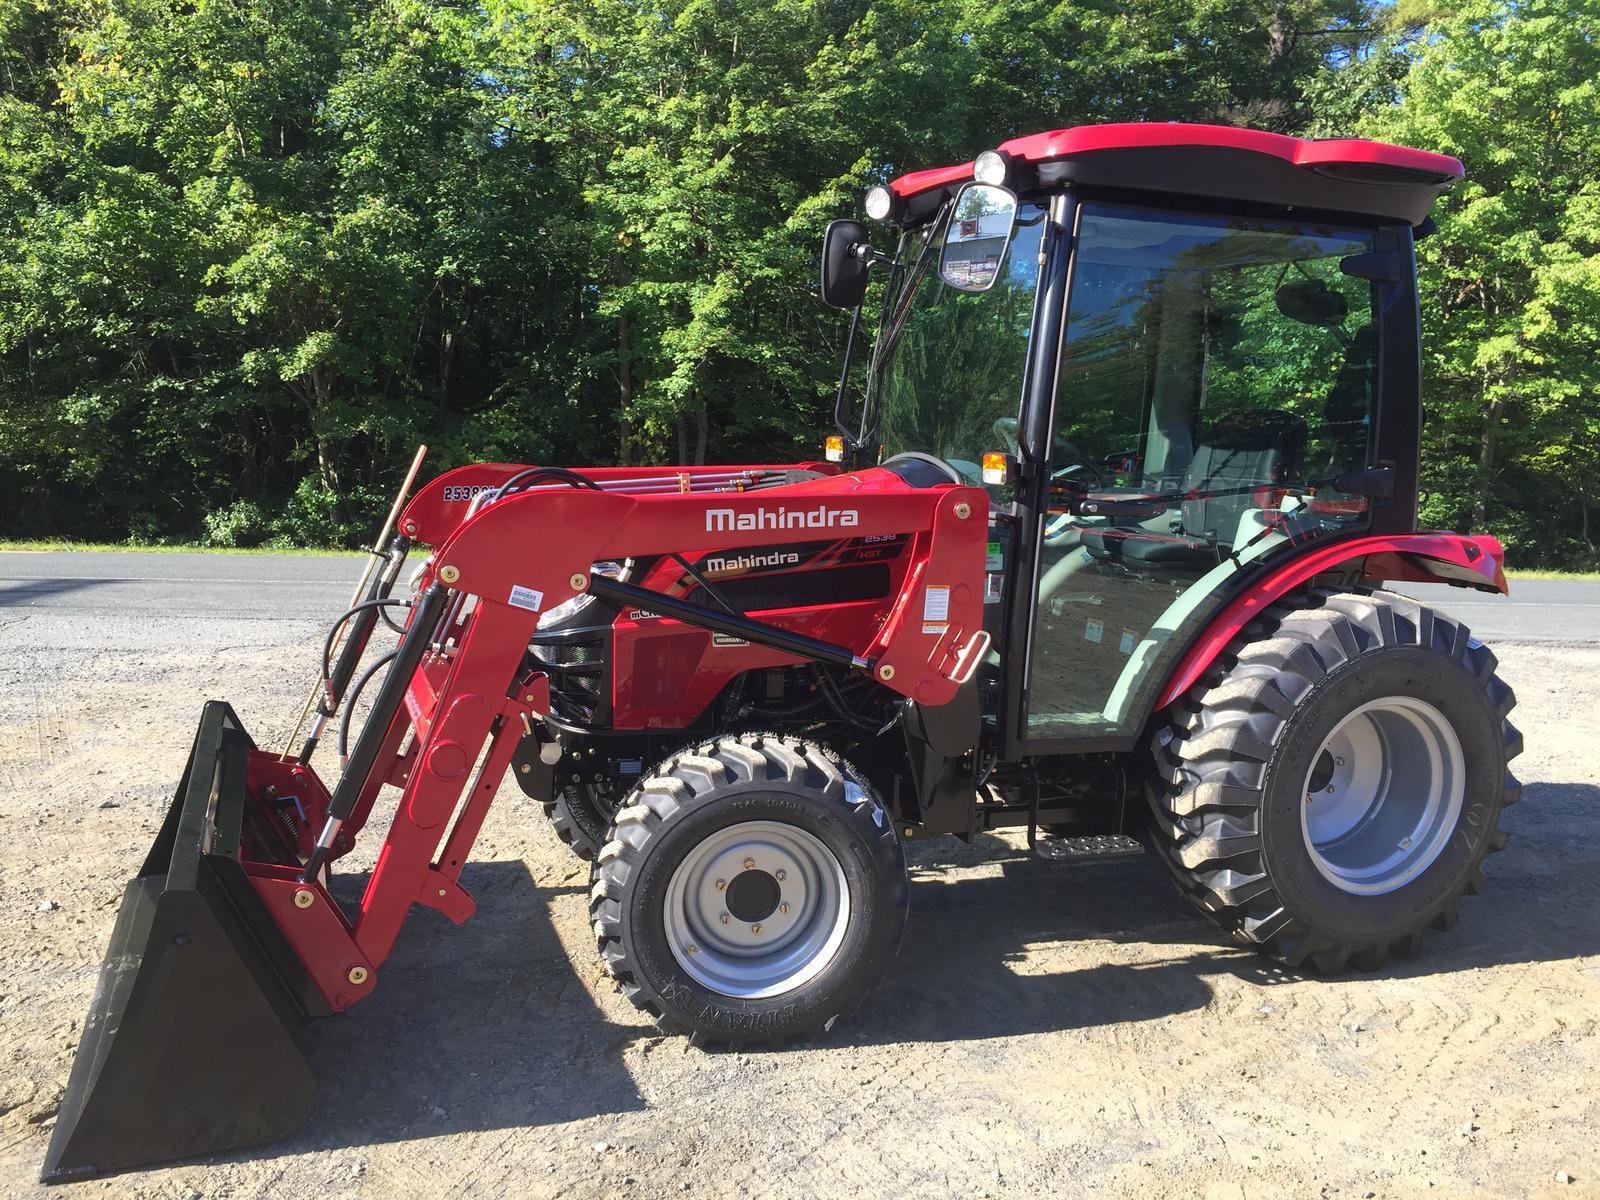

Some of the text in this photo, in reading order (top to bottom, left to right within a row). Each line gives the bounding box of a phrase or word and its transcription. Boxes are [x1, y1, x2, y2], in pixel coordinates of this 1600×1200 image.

[706, 505, 859, 532] Mahindra
[864, 533, 896, 543] 2538
[707, 551, 799, 573] Mahindra
